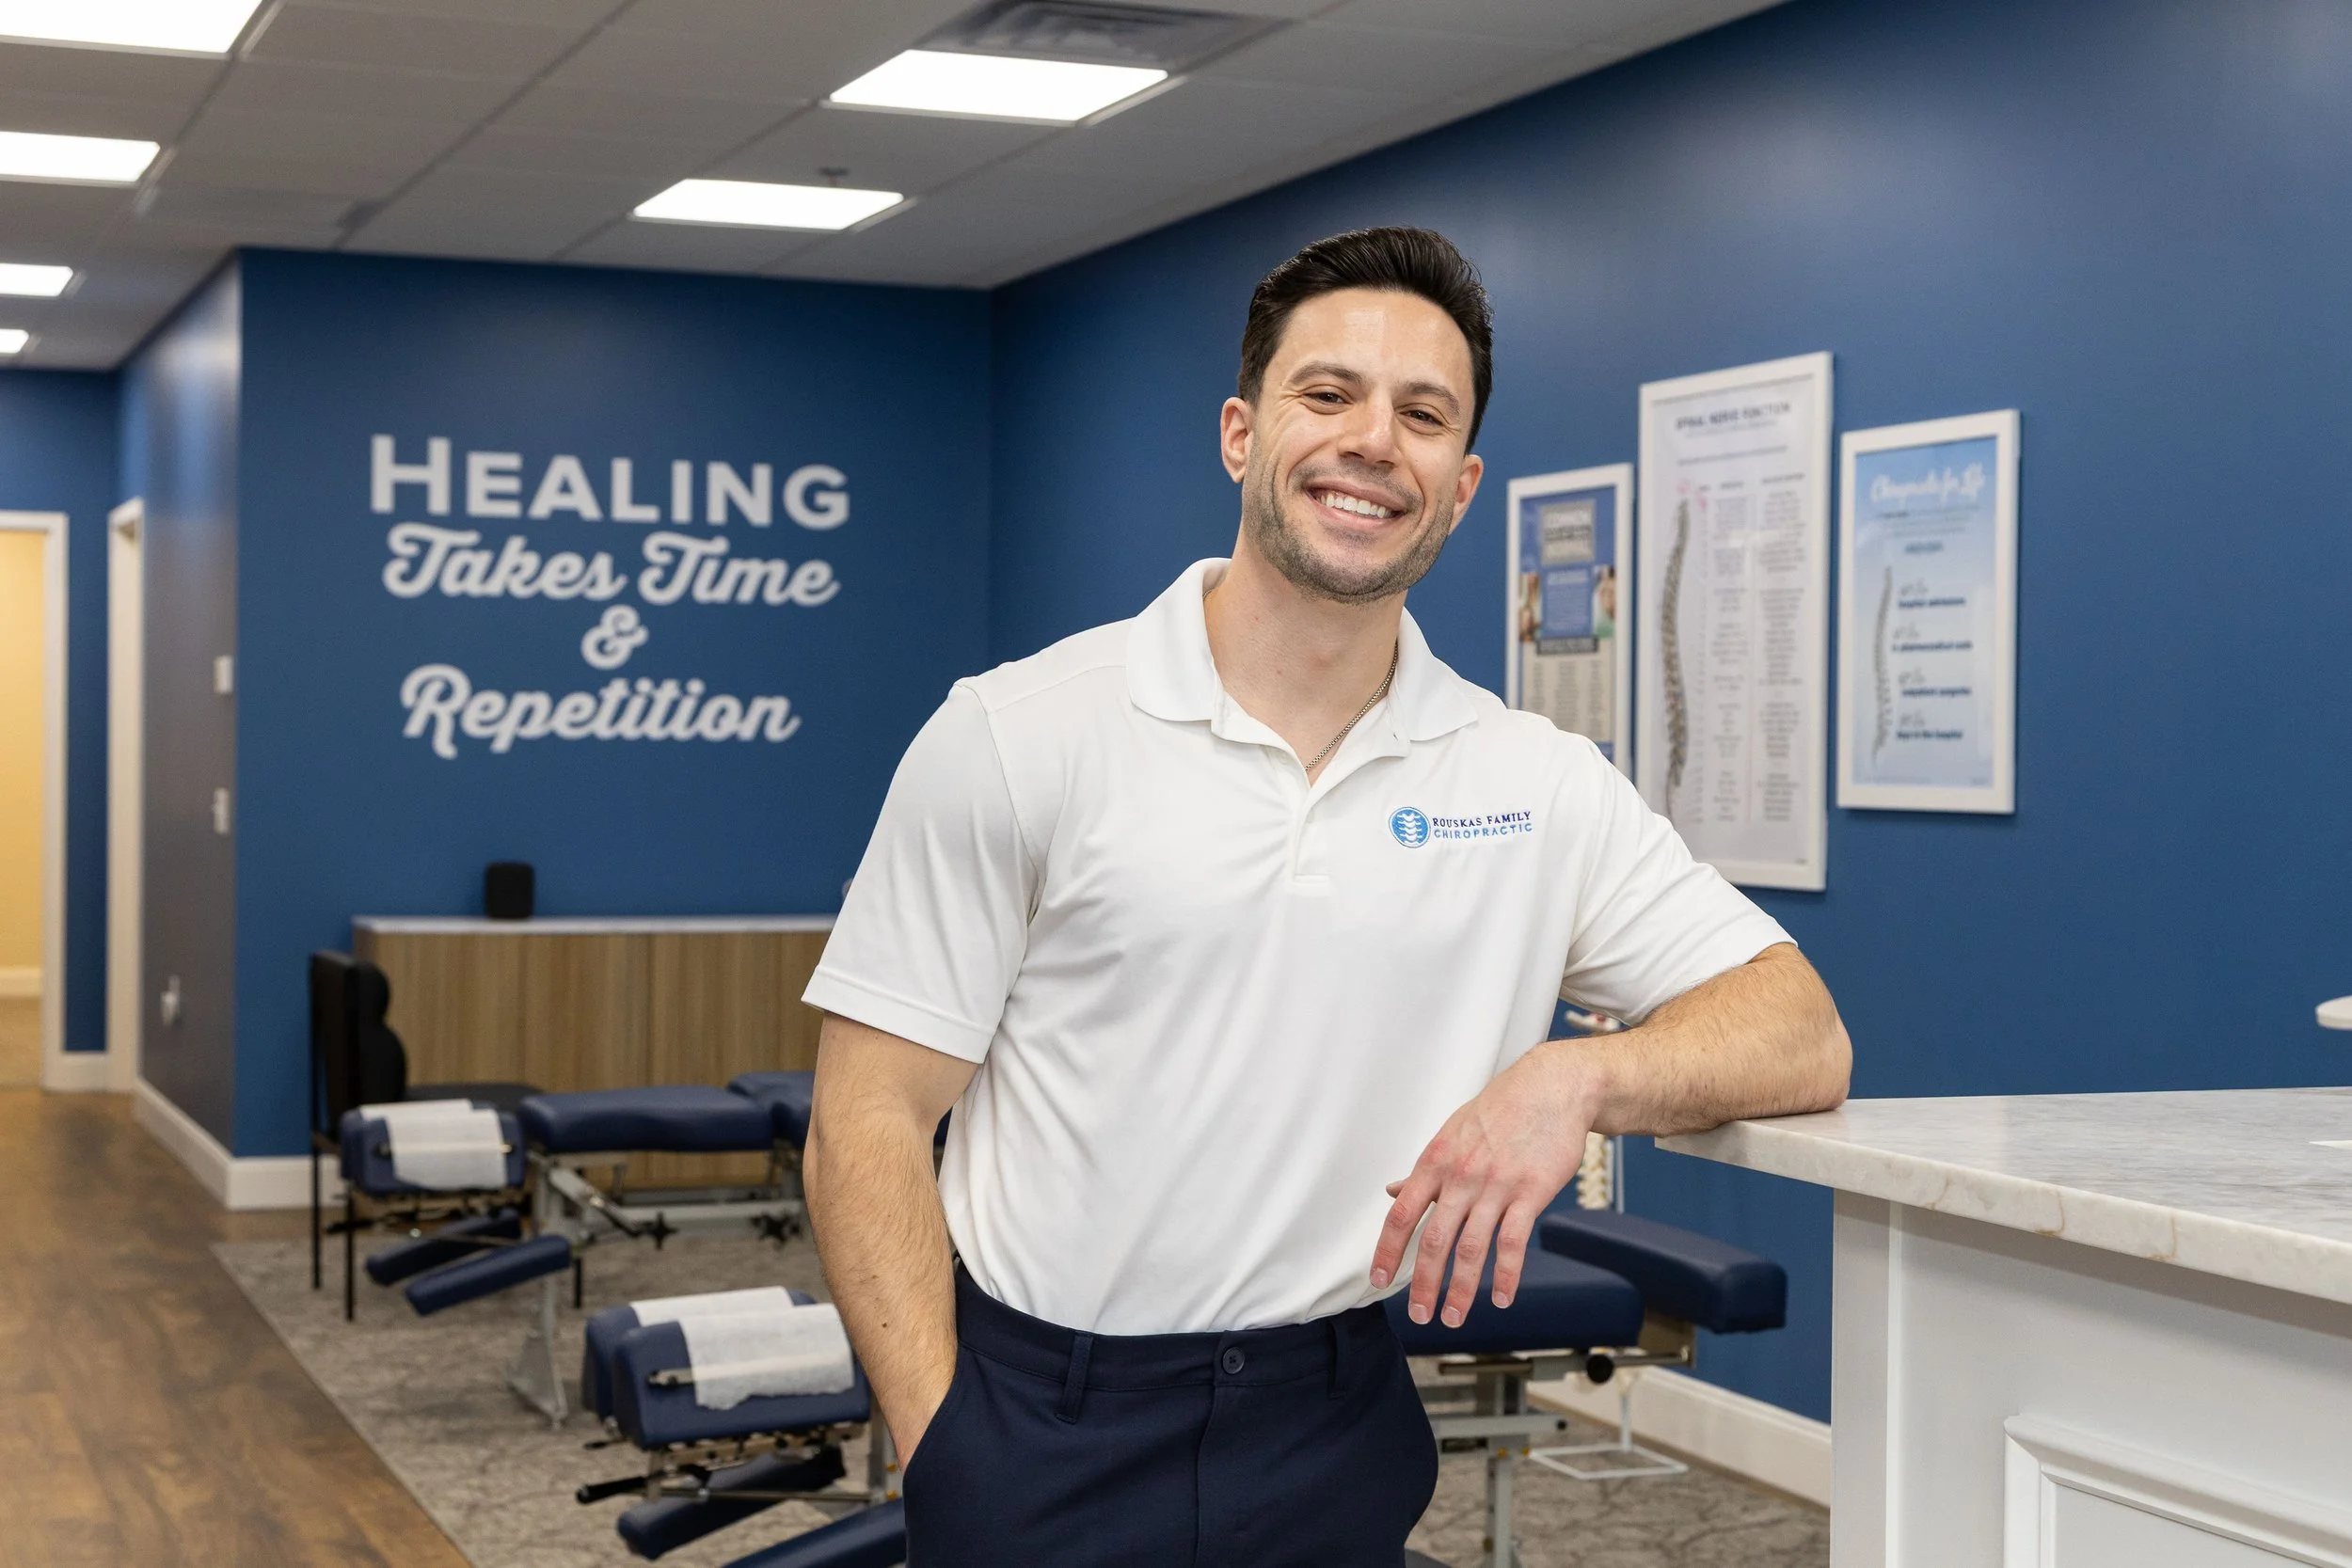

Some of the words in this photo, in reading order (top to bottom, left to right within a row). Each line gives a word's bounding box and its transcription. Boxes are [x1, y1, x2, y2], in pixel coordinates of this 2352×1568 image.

[370, 434, 850, 531] HEALING
[382, 522, 628, 601] Takes
[637, 531, 840, 607] Time
[580, 604, 648, 670] &
[400, 663, 802, 760] Repetition
[1432, 816, 1483, 828] ROUSKAS
[1486, 811, 1532, 825] FAMILY
[1434, 823, 1533, 839] CHIROPRACTIC
